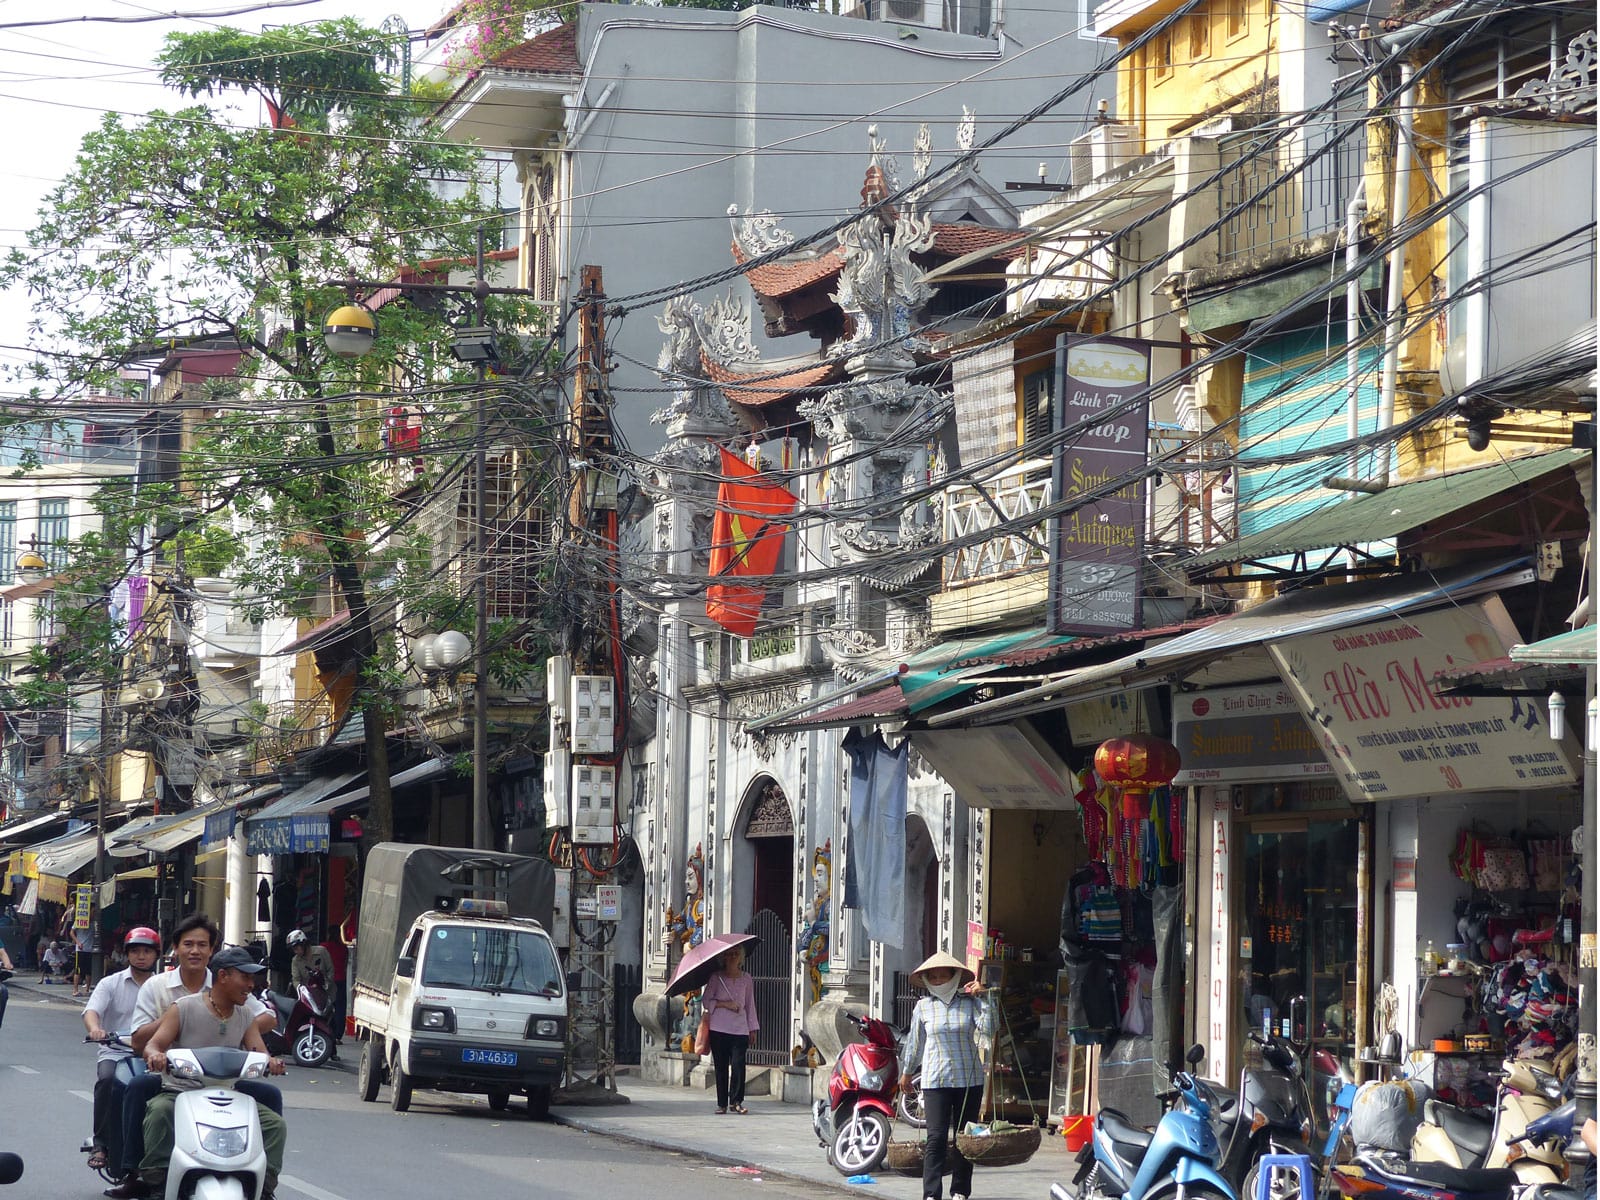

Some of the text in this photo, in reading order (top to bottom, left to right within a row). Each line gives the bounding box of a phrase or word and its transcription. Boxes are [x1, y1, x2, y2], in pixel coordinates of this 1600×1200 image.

[1069, 390, 1101, 408] Linh
[1066, 511, 1136, 556] Antiques
[1080, 565, 1117, 585] 32
[1324, 661, 1391, 722] Hà
[1439, 765, 1463, 790] 30
